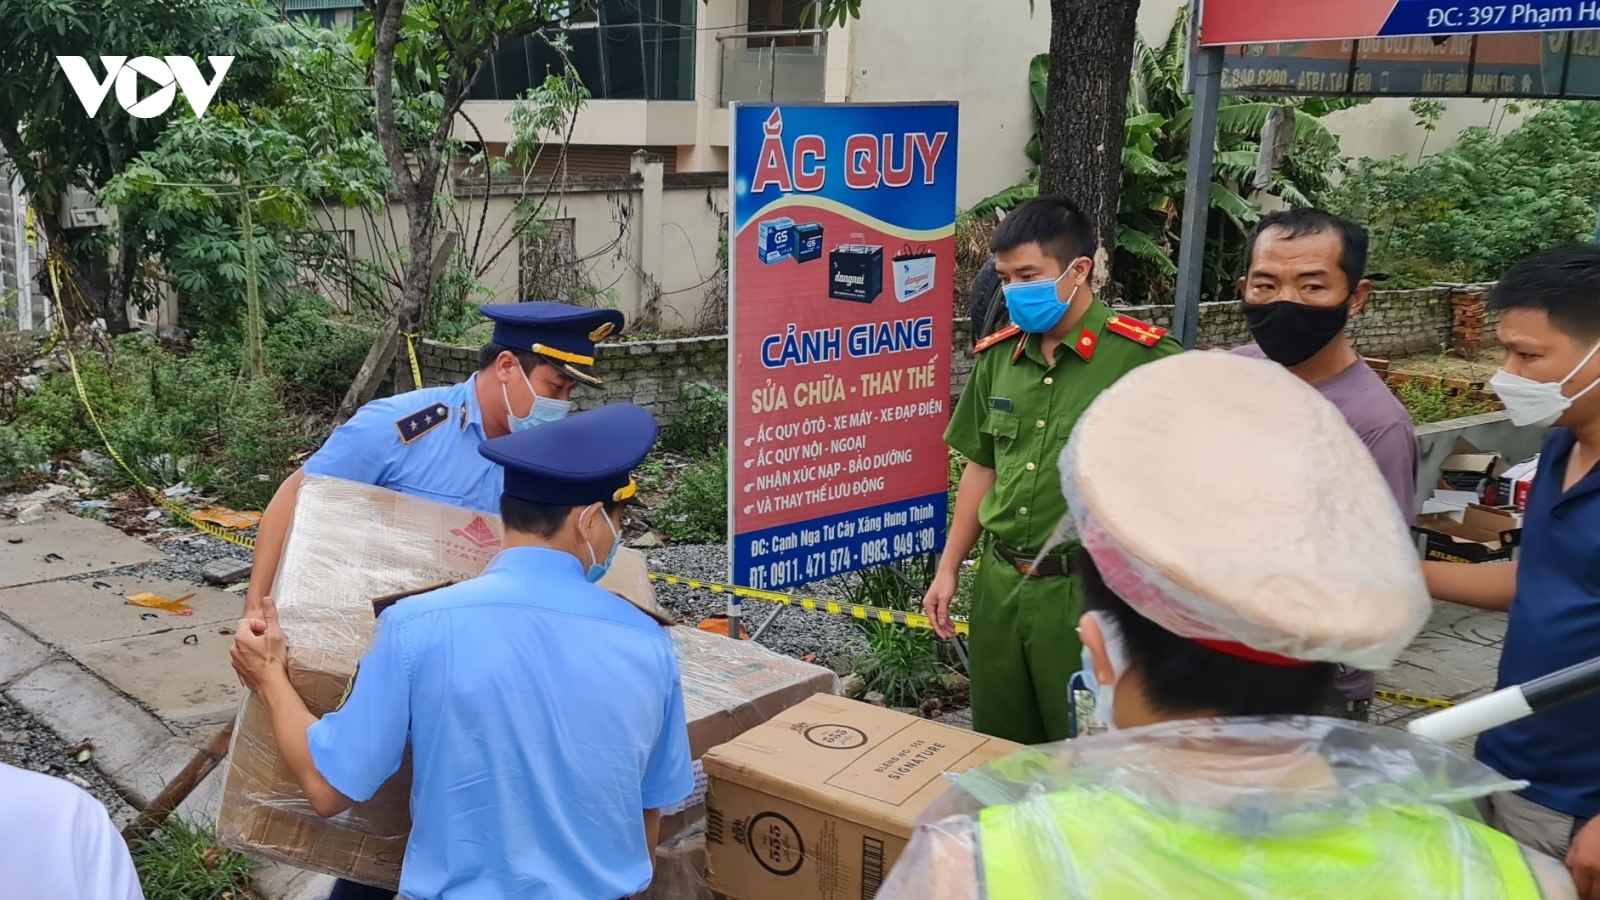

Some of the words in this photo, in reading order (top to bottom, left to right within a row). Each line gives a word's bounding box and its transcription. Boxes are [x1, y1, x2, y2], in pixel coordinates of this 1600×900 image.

[1427, 7, 1463, 27] ĐC:
[1469, 6, 1507, 25] 397
[1511, 2, 1572, 27] Phạm
[751, 107, 826, 193] ẮC
[844, 132, 949, 189] QUY
[774, 230, 788, 244] GS
[806, 239, 816, 248] GS
[761, 323, 841, 369] CẢNH
[848, 316, 933, 358] GIANG
[751, 378, 788, 414] SỬA
[794, 374, 846, 407] CHỮA
[861, 369, 903, 397] THAY
[907, 354, 938, 388] THẾ
[757, 422, 773, 442] ẮC
[775, 422, 800, 439] QUY
[802, 415, 826, 435] ÔTÔ
[834, 415, 847, 431] XE
[850, 409, 872, 427] MÁY
[880, 406, 894, 422] XE
[895, 402, 916, 422] ĐẠP
[918, 398, 943, 418] ĐIỆN
[757, 448, 773, 467] ẮC
[775, 447, 800, 463] QUY
[802, 441, 823, 461] NỘI
[831, 435, 866, 454] NGOẠI
[756, 471, 791, 492] NHẬN
[793, 465, 816, 485] XÚC
[818, 463, 841, 482] NẠP
[849, 453, 872, 473] BẢO
[873, 449, 912, 469] DƯỠNG
[756, 495, 772, 514] VÀ
[774, 491, 803, 510] THAY
[805, 483, 827, 505] THẾ
[828, 483, 850, 500] LƯU
[853, 476, 884, 495] ĐỘNG
[751, 538, 769, 558] ĐC:
[772, 533, 798, 555] Cạnh
[800, 529, 820, 547] Nga
[823, 524, 835, 541] Tư
[837, 518, 855, 539] Cây
[857, 515, 882, 533] Xăng
[883, 510, 907, 528] Hưng
[909, 503, 934, 524] Thịnh
[806, 552, 826, 578] 471
[830, 546, 850, 573] 974
[893, 531, 914, 554] 949
[823, 729, 847, 743] 555
[875, 757, 899, 774] BLEND
[888, 742, 946, 780] SIGNATURE
[769, 823, 781, 862] 555
